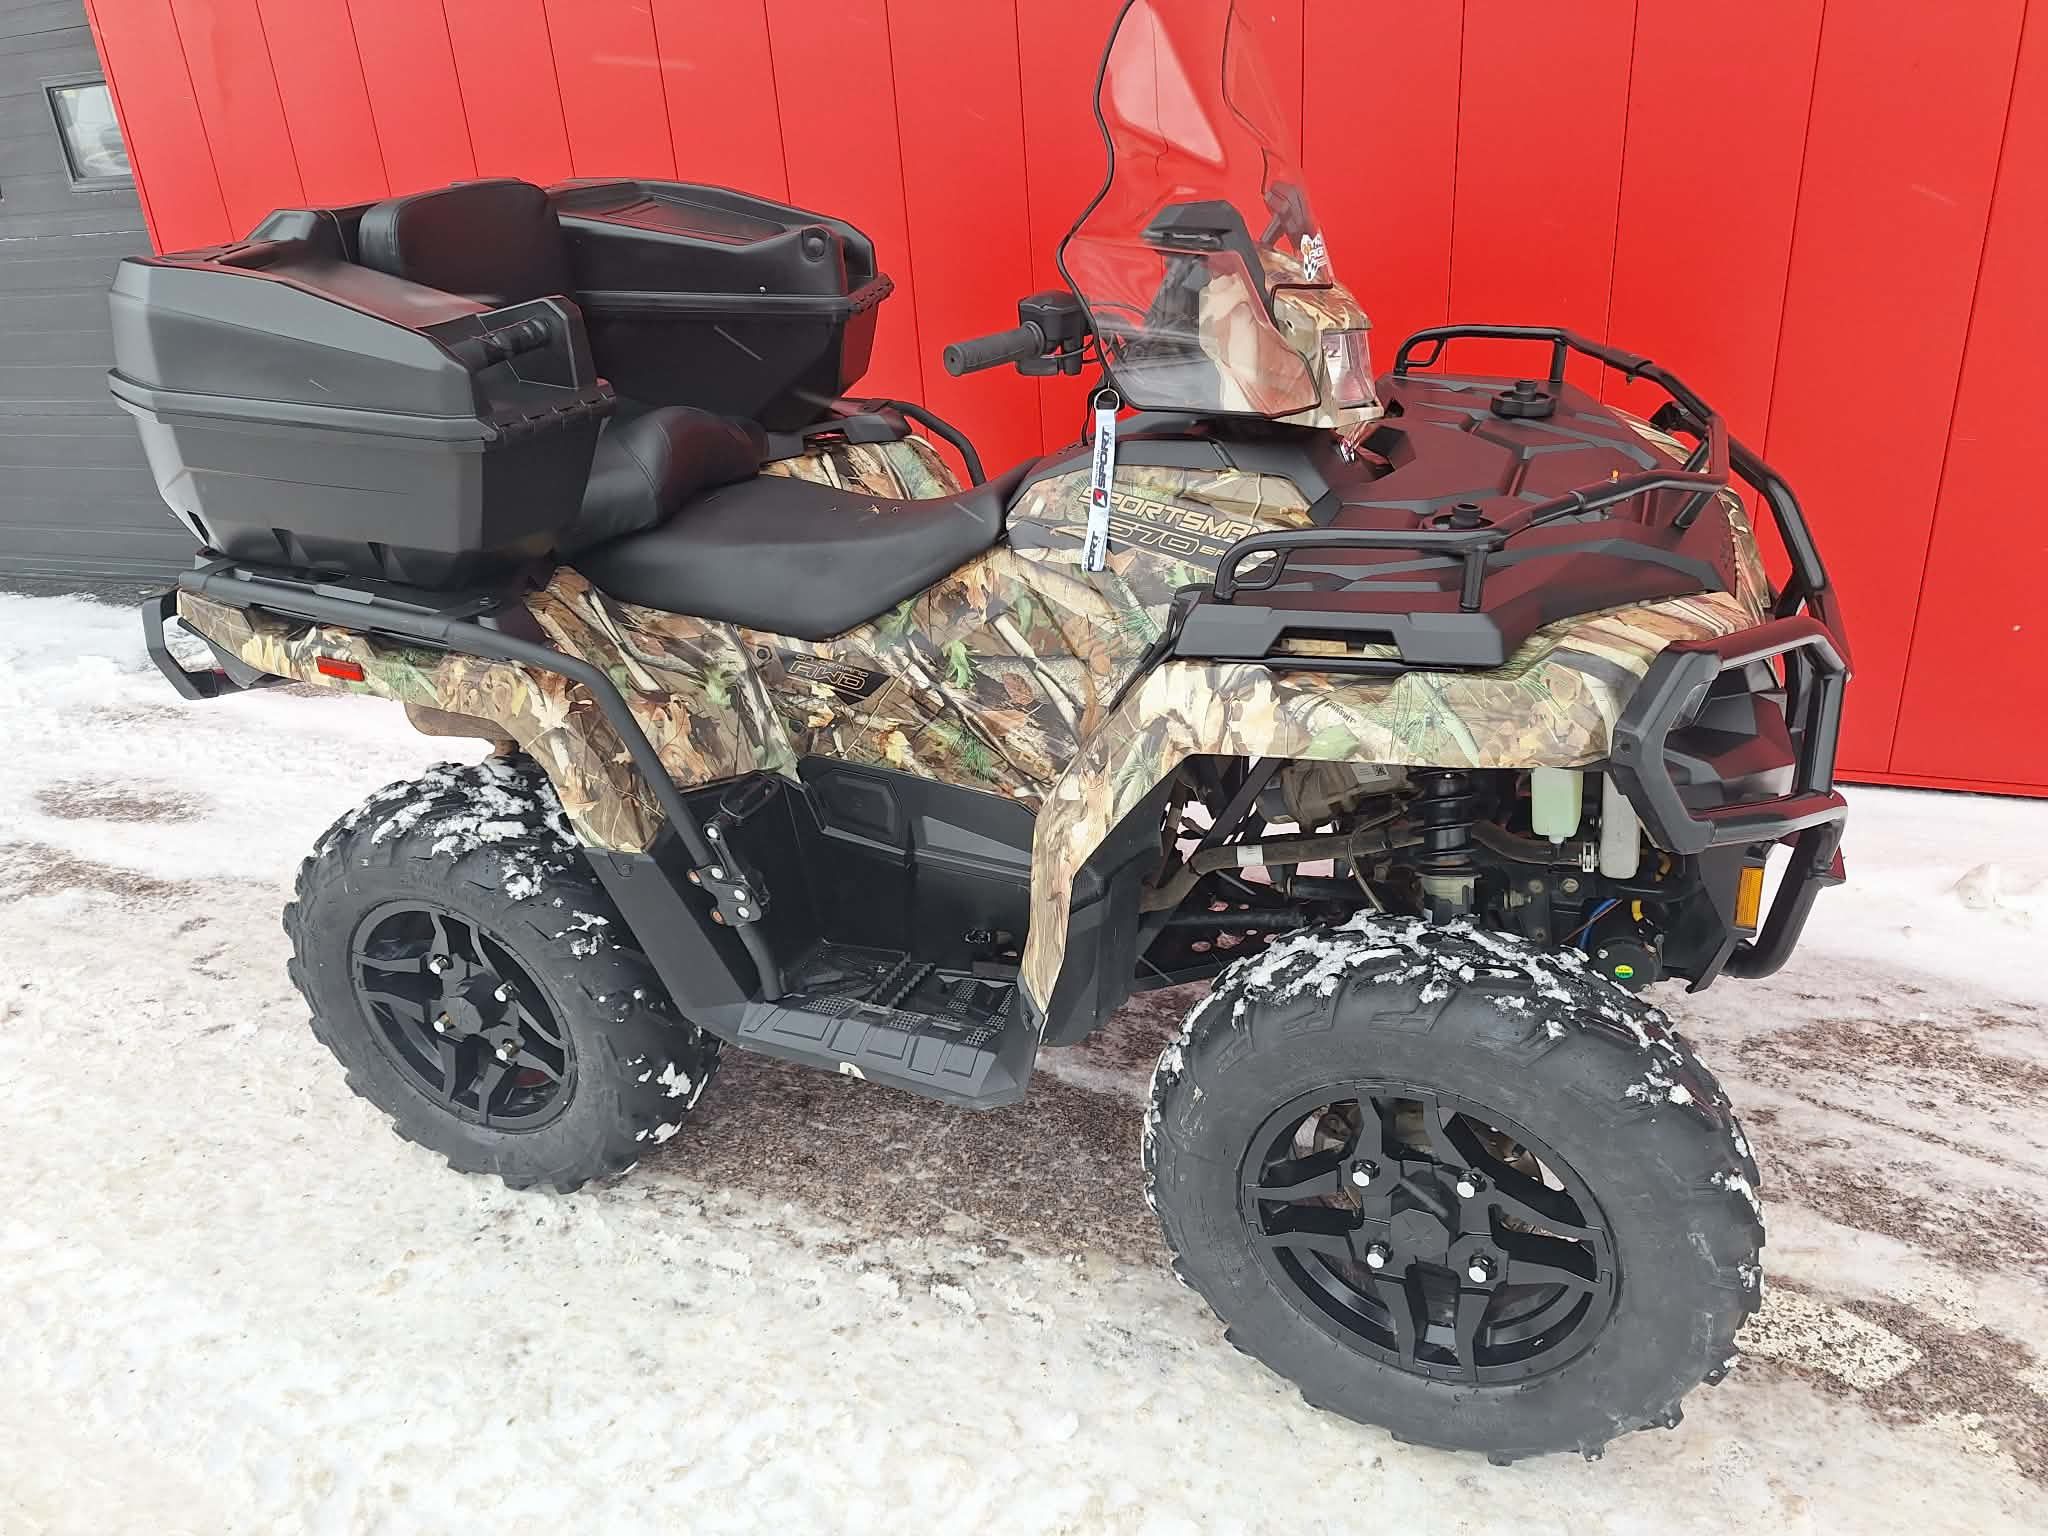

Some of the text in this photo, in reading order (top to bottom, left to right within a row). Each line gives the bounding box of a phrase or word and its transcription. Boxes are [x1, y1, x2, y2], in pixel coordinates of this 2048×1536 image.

[1098, 425, 1110, 489] SPORT
[1110, 516, 1201, 556] 570
[787, 660, 866, 690] AWD
